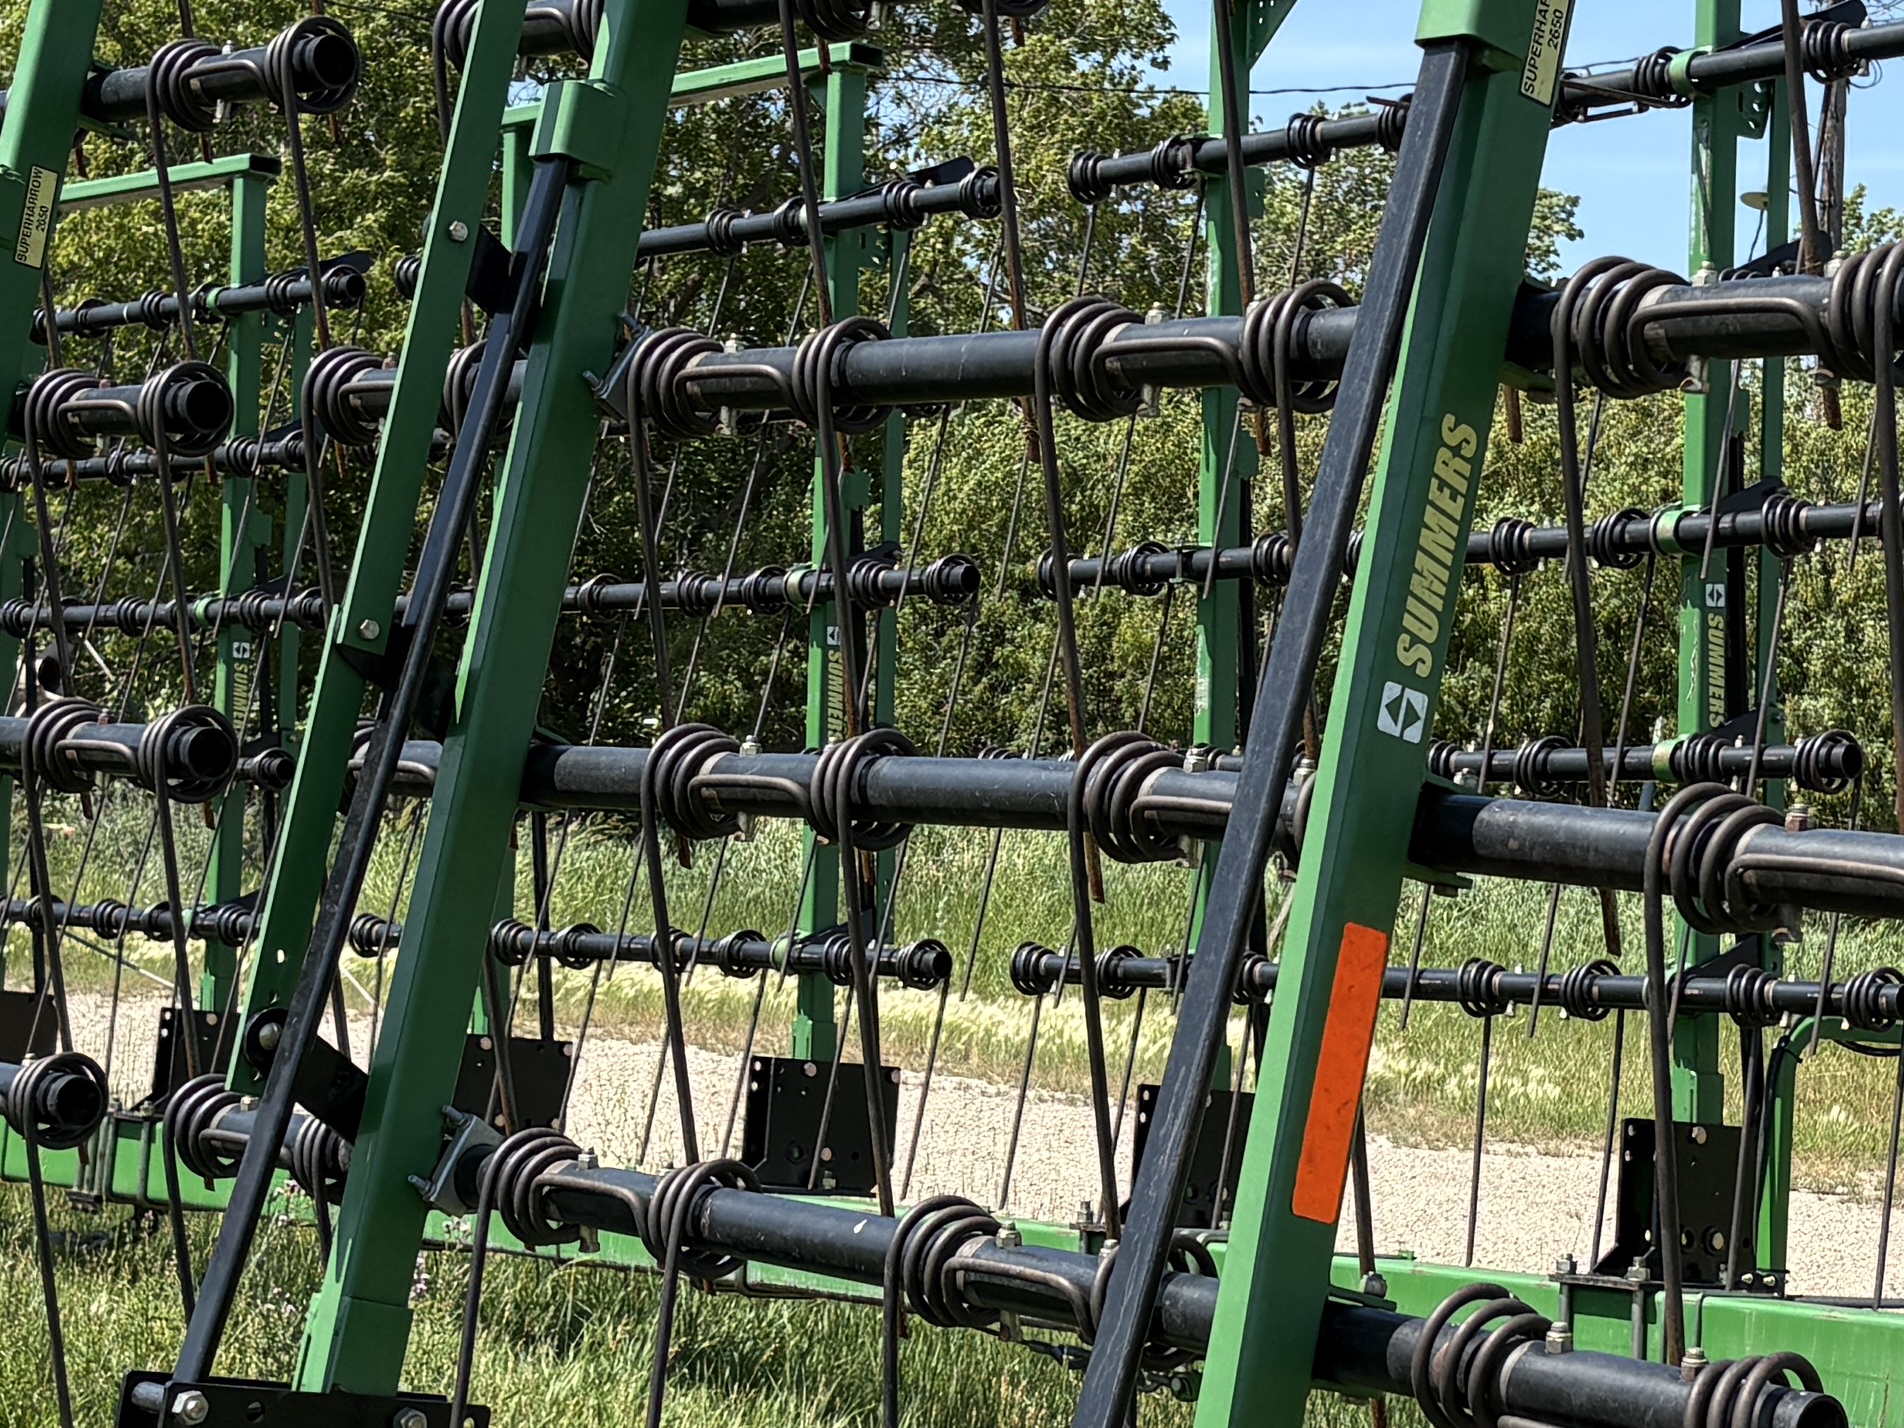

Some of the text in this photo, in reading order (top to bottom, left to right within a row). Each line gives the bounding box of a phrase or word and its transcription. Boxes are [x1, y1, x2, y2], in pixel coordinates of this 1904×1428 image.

[1548, 9, 1564, 51] 2650
[17, 167, 44, 262] SUPERHARROW
[1397, 413, 1478, 678] SUMMERS
[1708, 613, 1726, 728] SUMMERS
